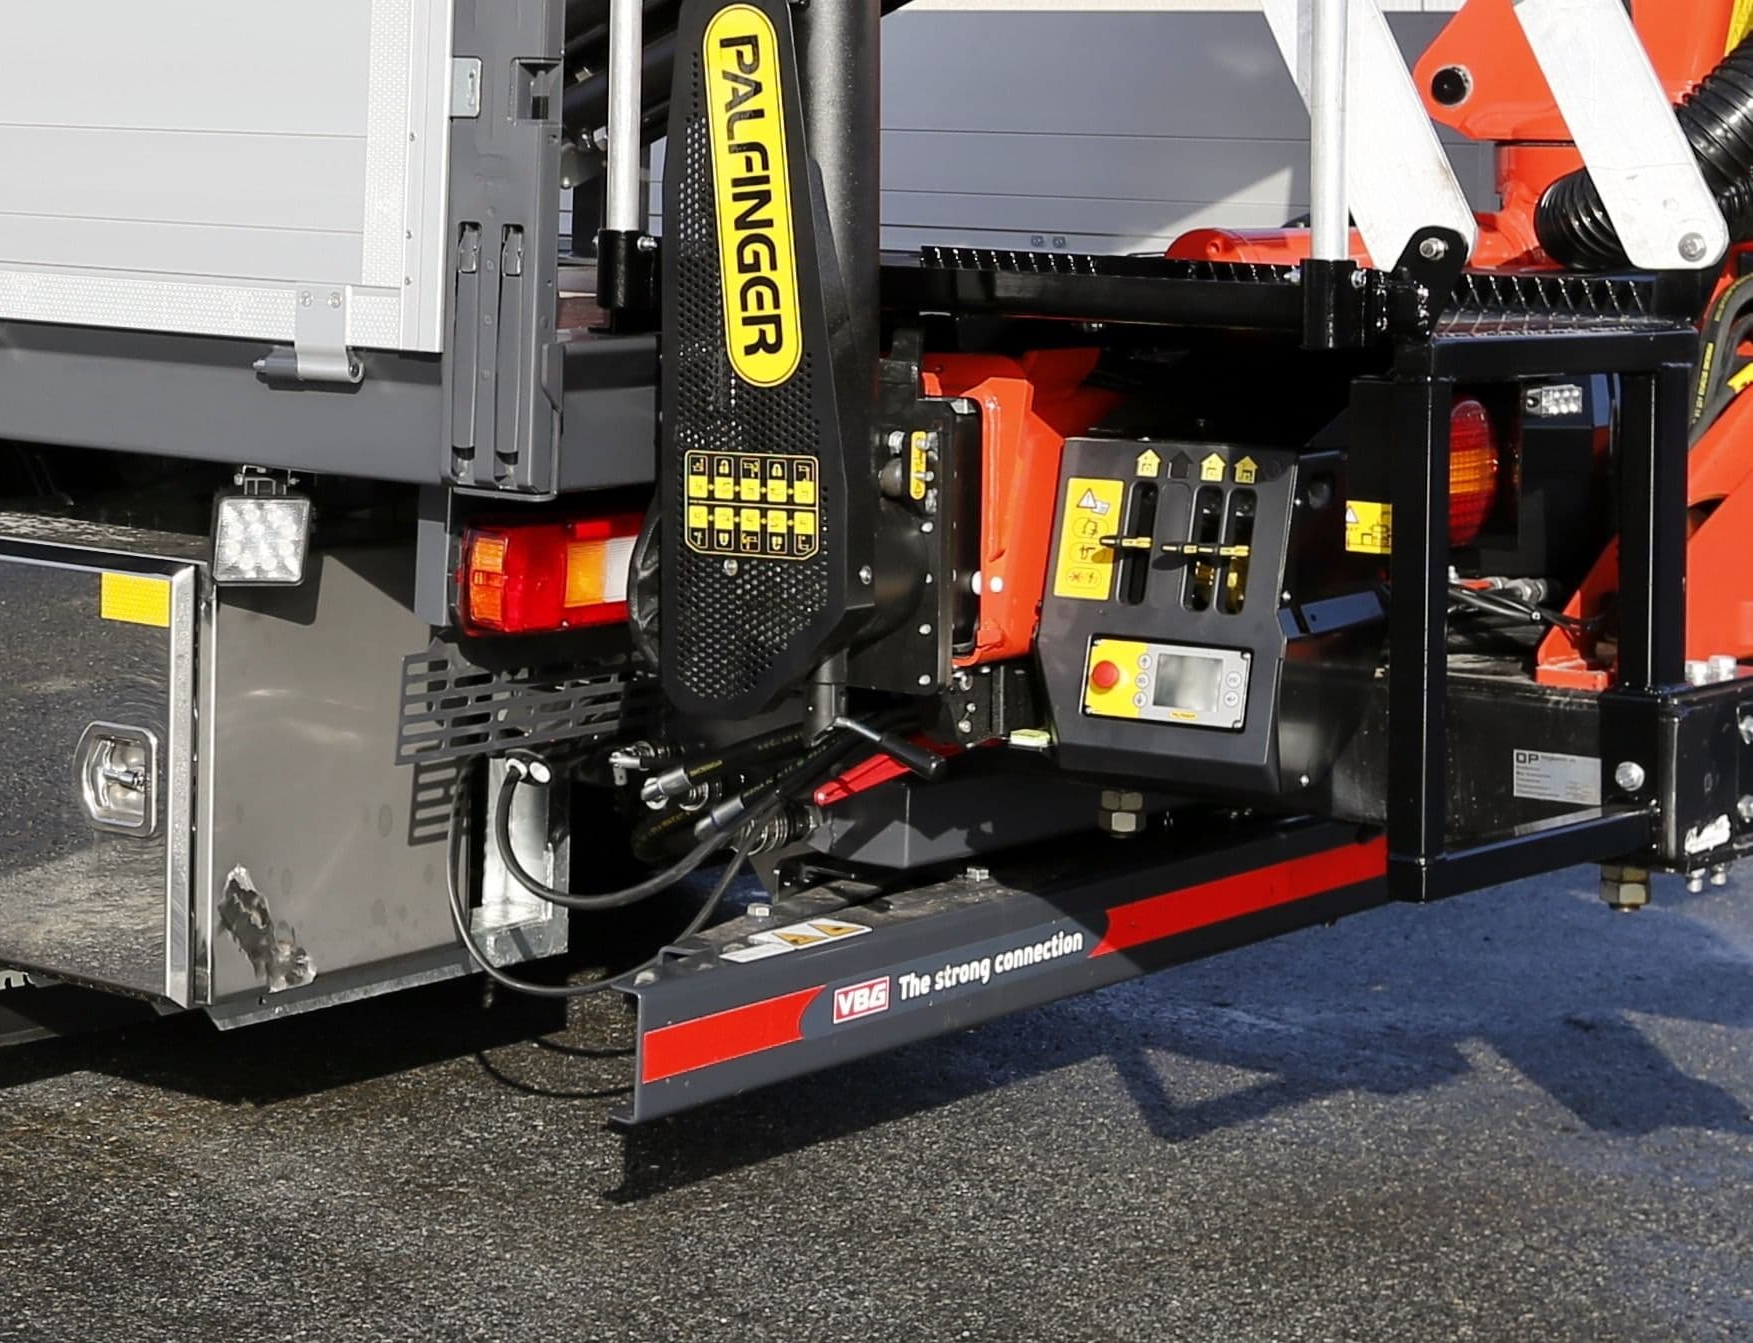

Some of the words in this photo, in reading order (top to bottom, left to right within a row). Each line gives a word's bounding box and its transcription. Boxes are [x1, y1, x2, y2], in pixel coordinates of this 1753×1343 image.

[719, 34, 783, 356] PALFINGER
[836, 983, 888, 1017] VBG
[898, 972, 931, 1001] The
[933, 957, 991, 991] strong
[994, 931, 1083, 974] connection
